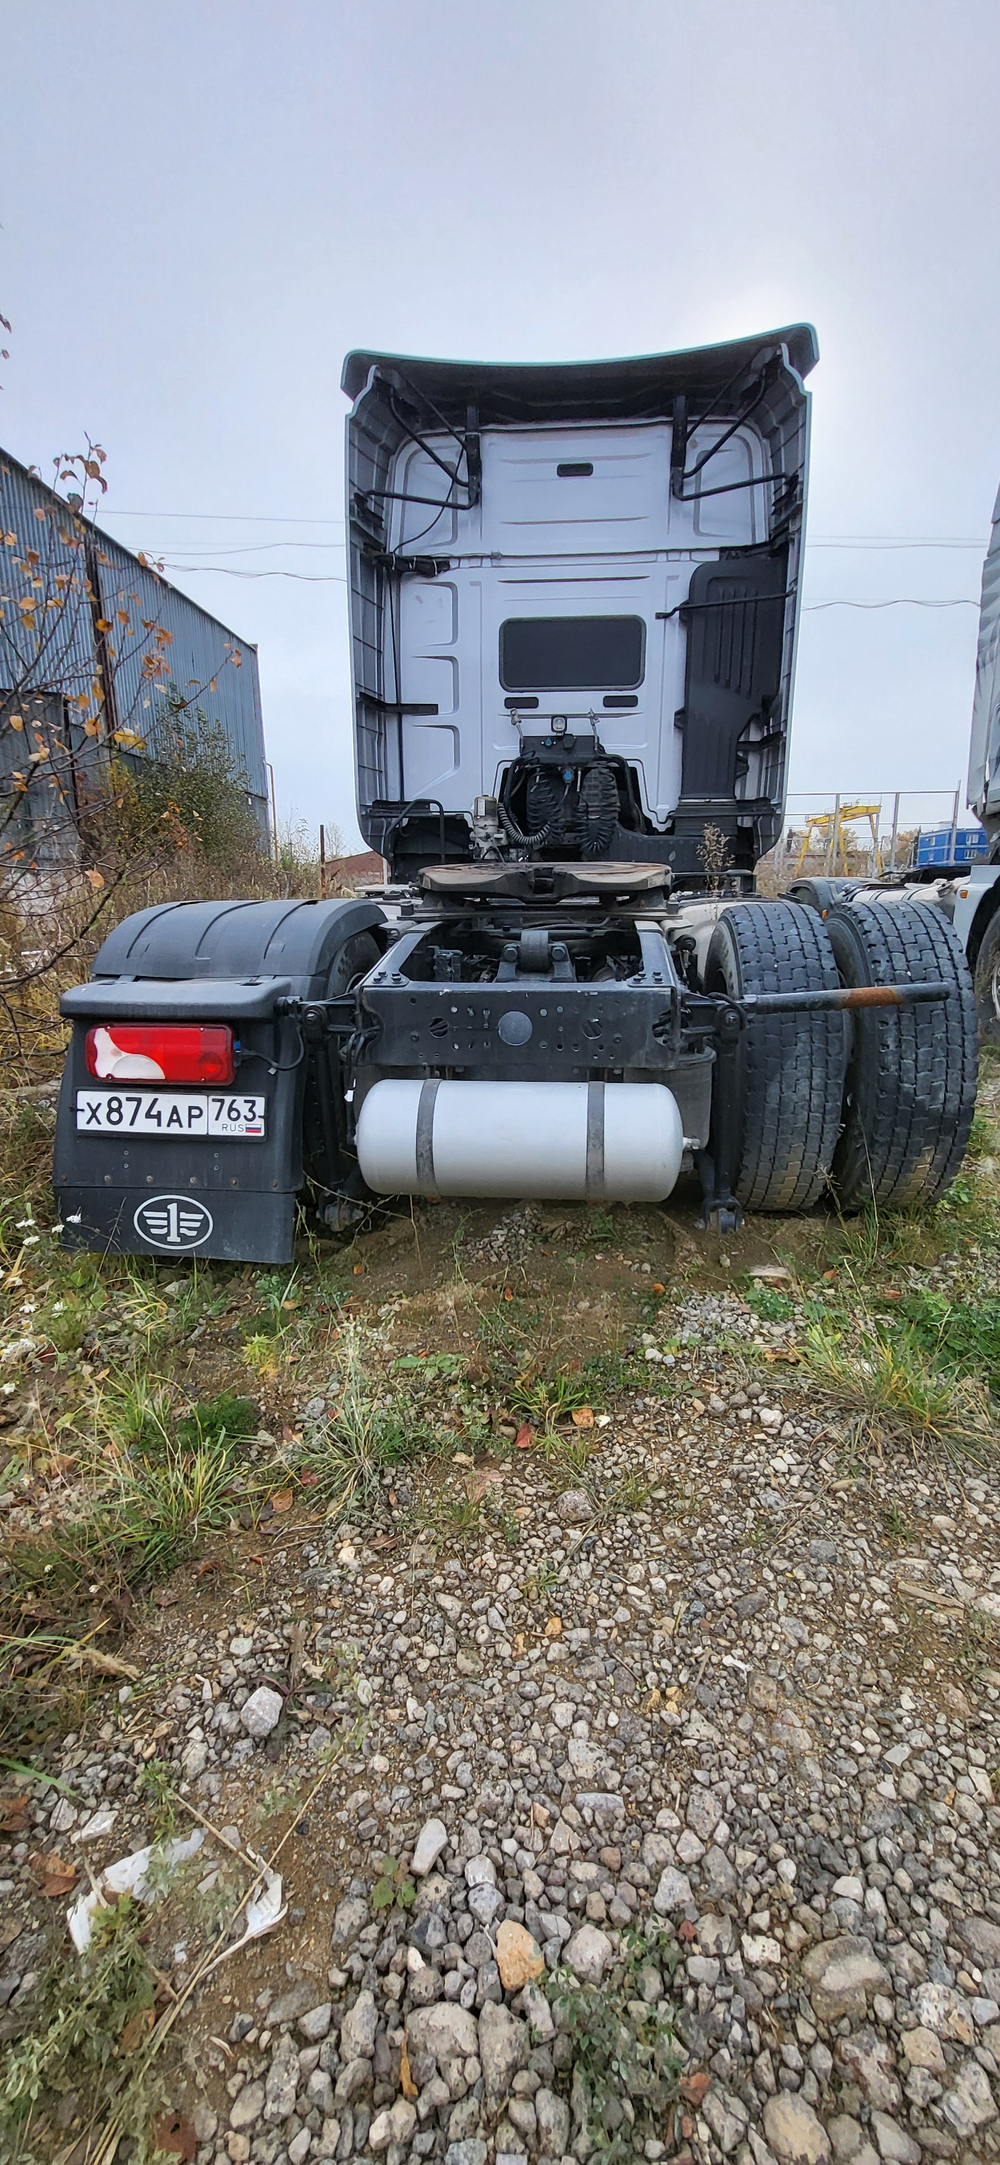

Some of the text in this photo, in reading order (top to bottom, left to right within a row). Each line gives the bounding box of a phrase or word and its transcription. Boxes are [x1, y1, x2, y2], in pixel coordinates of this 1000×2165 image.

[85, 1096, 257, 1129] Х874АР 763
[221, 1123, 245, 1133] RUS
